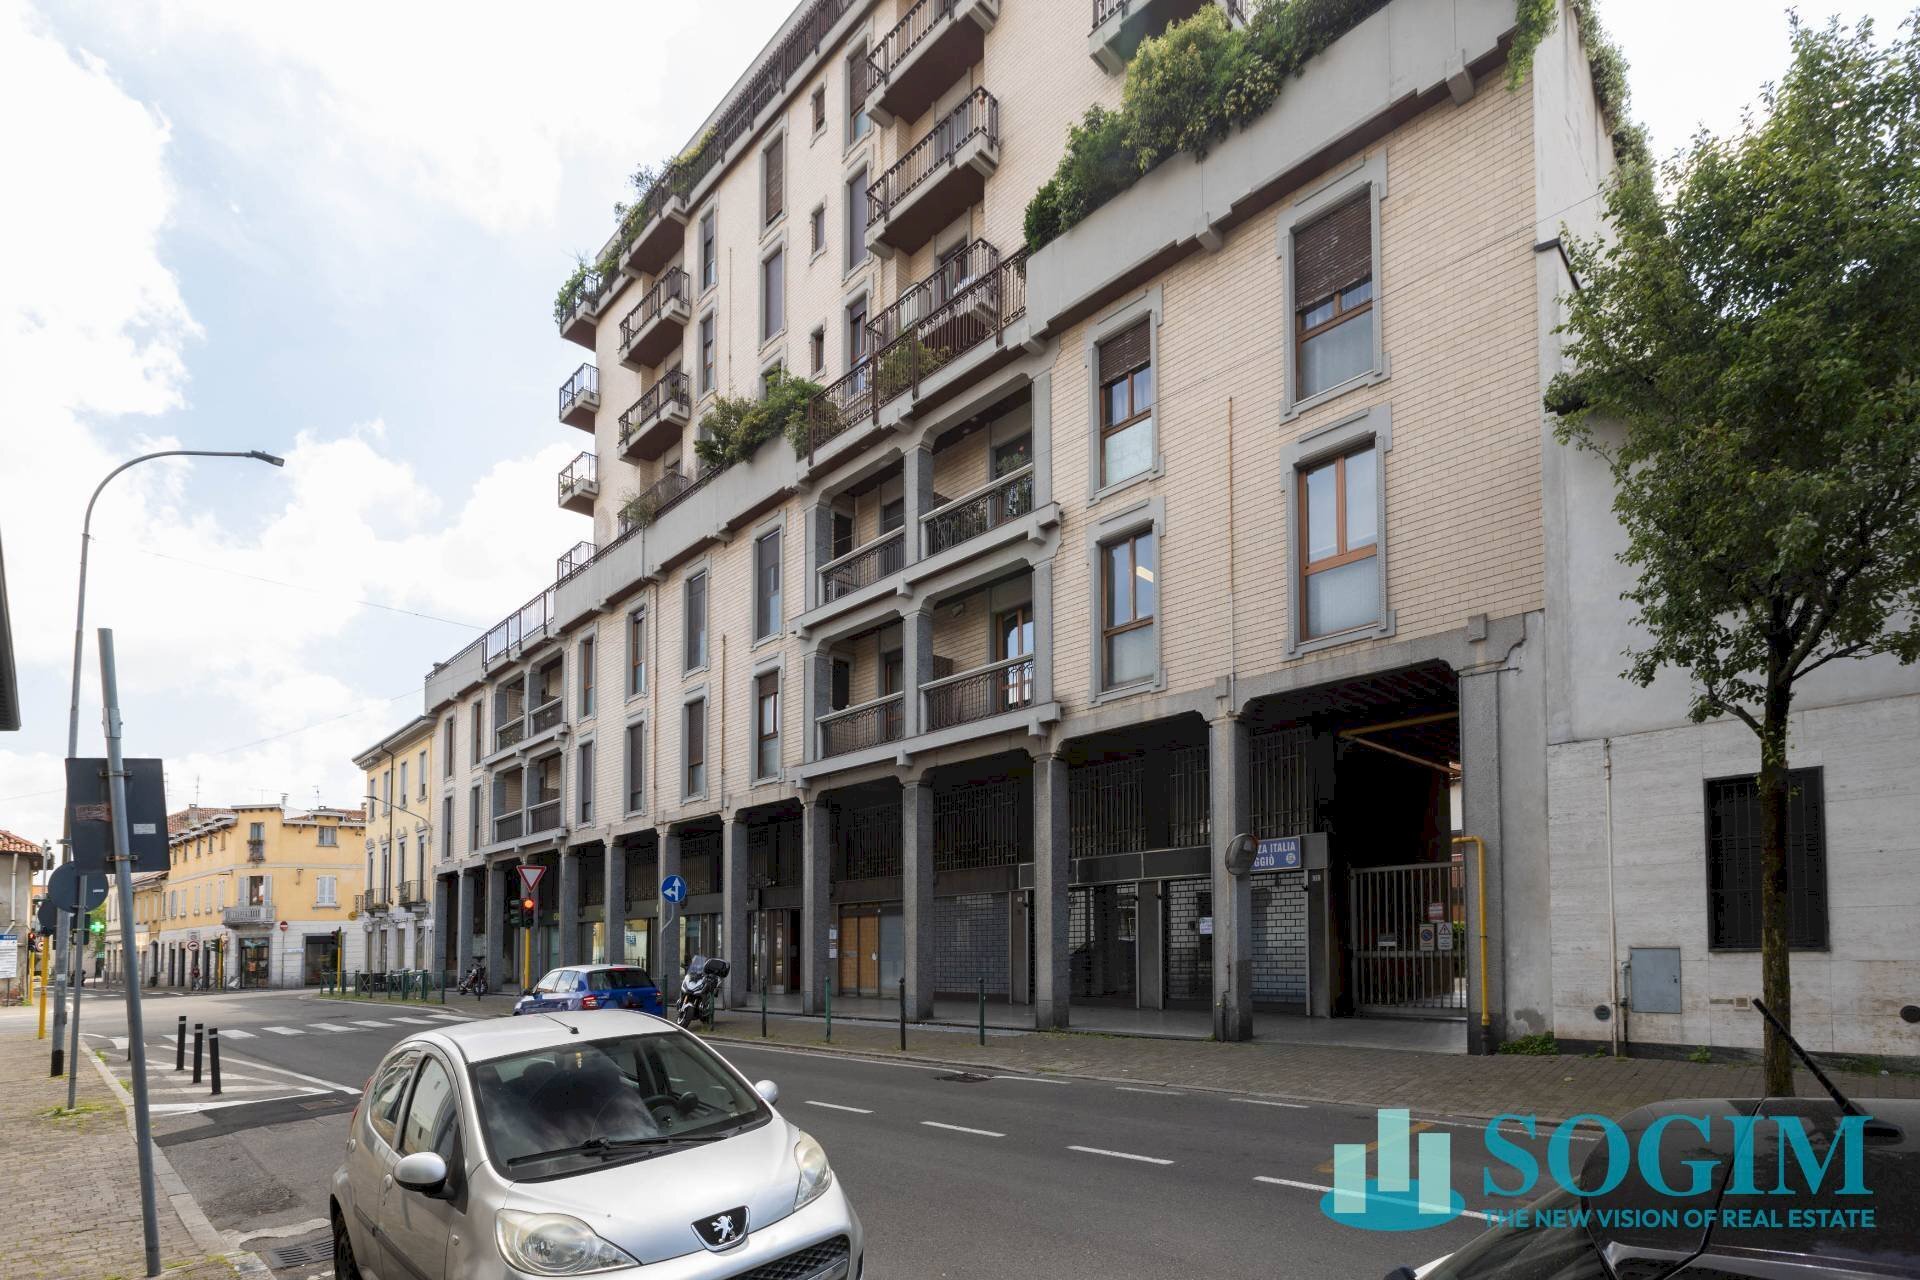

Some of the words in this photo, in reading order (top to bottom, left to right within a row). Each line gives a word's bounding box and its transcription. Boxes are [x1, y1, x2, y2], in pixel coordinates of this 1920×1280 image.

[1257, 844, 1268, 854] ZA
[1270, 841, 1296, 853] ITALIA
[1254, 853, 1275, 867] GGIÒ
